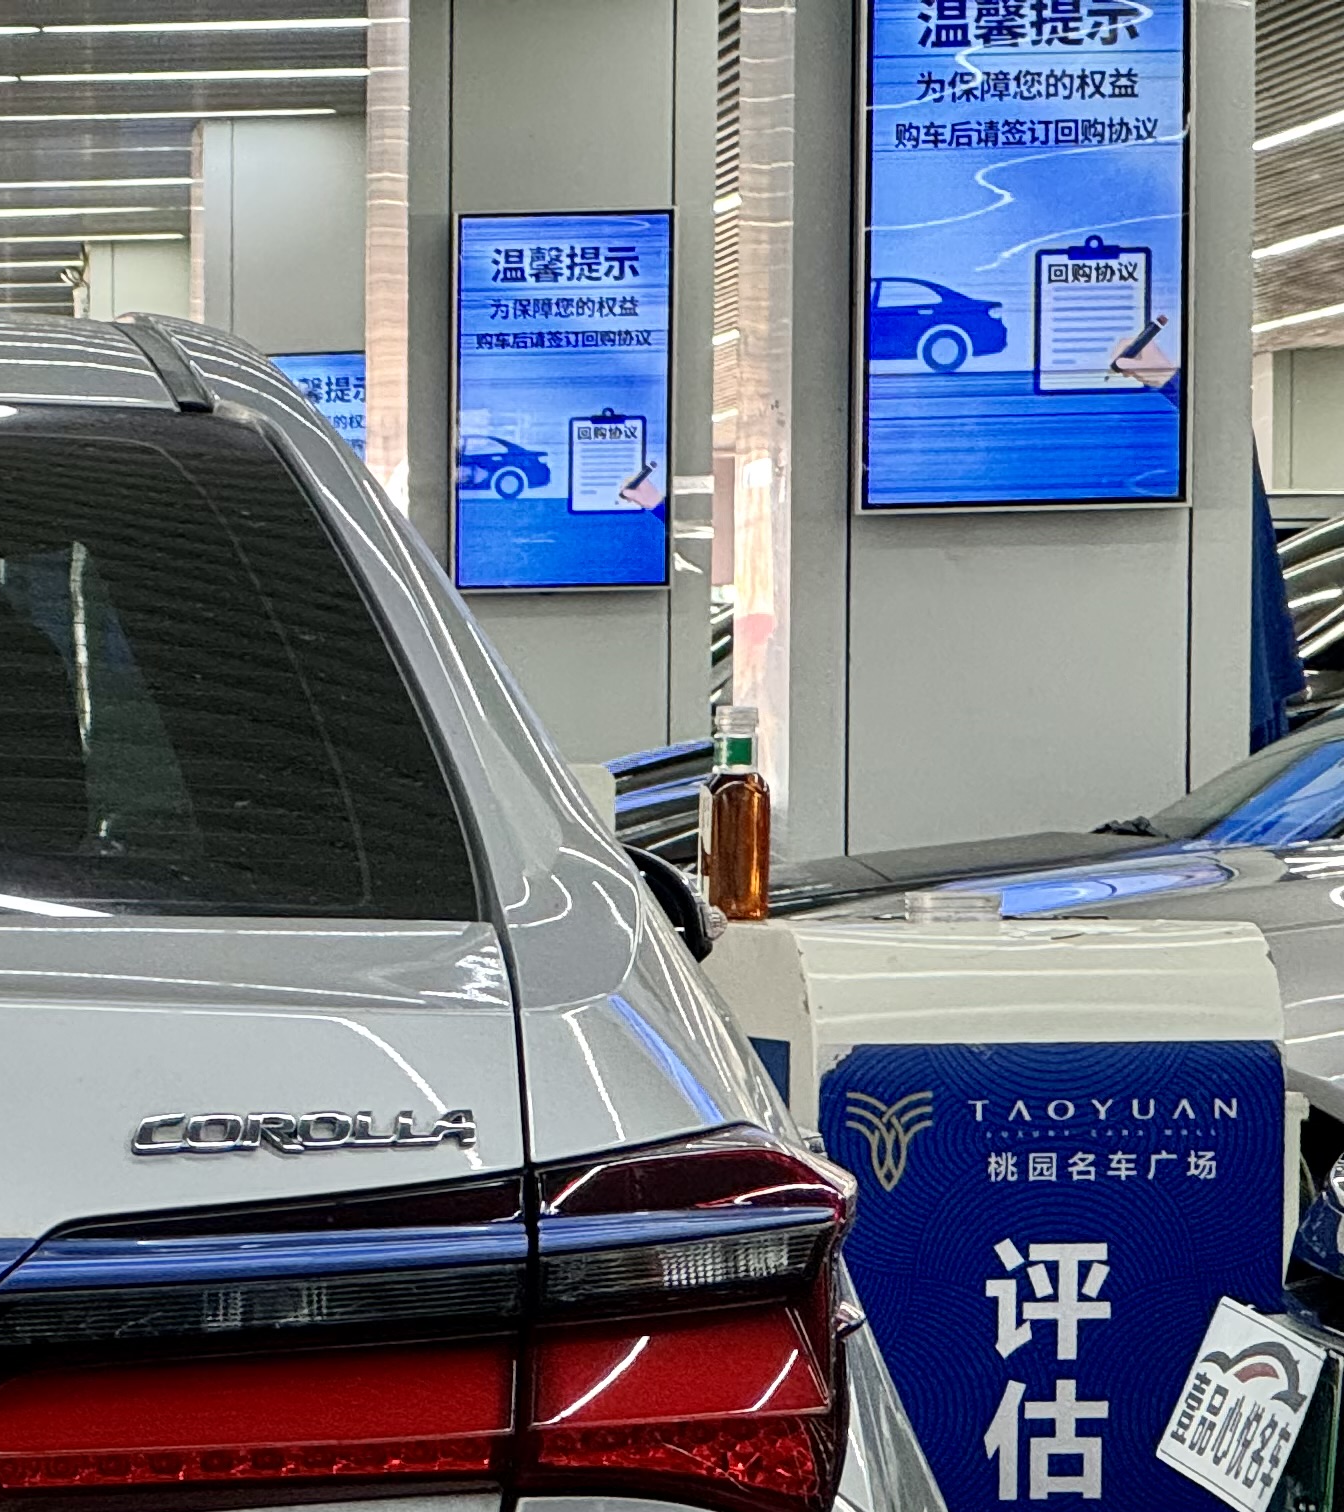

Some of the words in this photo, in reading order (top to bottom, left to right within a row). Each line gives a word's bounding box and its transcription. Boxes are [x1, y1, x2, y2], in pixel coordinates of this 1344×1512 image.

[917, 0, 1140, 48] 温馨提示
[916, 67, 1139, 103] 为保障您的权益
[894, 117, 1159, 149] 购车后请签订回购协议
[491, 246, 640, 283] 温馨提示
[1047, 261, 1139, 284] 回购协议
[490, 296, 639, 319] 为保障您的权益
[476, 329, 653, 350] 购车后请签订回购协议
[577, 425, 638, 440] 回购协议
[968, 1097, 1238, 1121] TAOYUAN
[131, 1109, 476, 1156] COROLLA
[987, 1150, 1217, 1182] 桃园名车广场
[984, 1237, 1111, 1501] 评估
